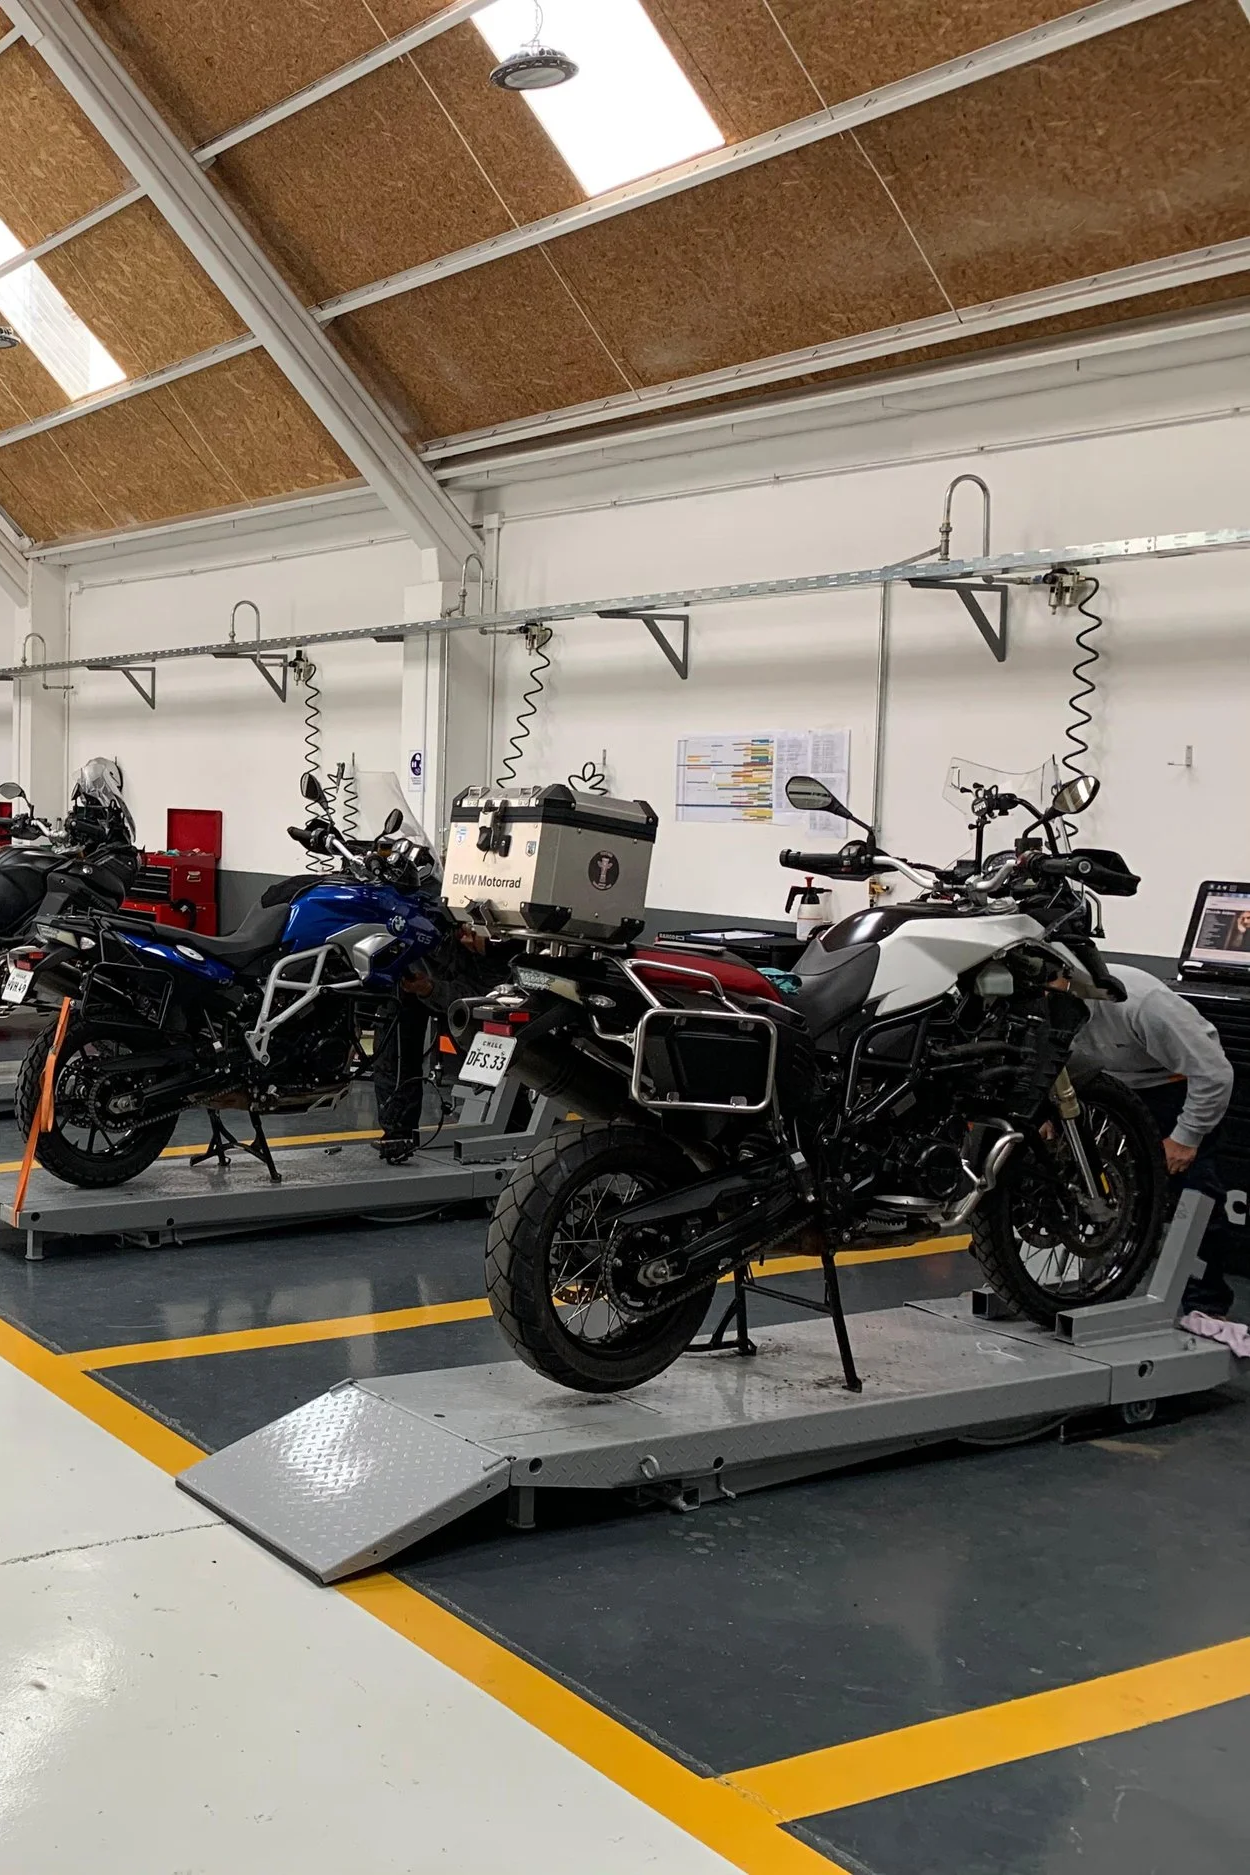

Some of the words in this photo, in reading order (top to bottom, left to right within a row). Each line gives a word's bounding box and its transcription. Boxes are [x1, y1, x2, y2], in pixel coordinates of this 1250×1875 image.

[452, 873, 478, 887] BMW
[478, 874, 522, 889] Motorrad
[482, 1040, 503, 1050] CHILE
[466, 1050, 507, 1071] DFS.33
